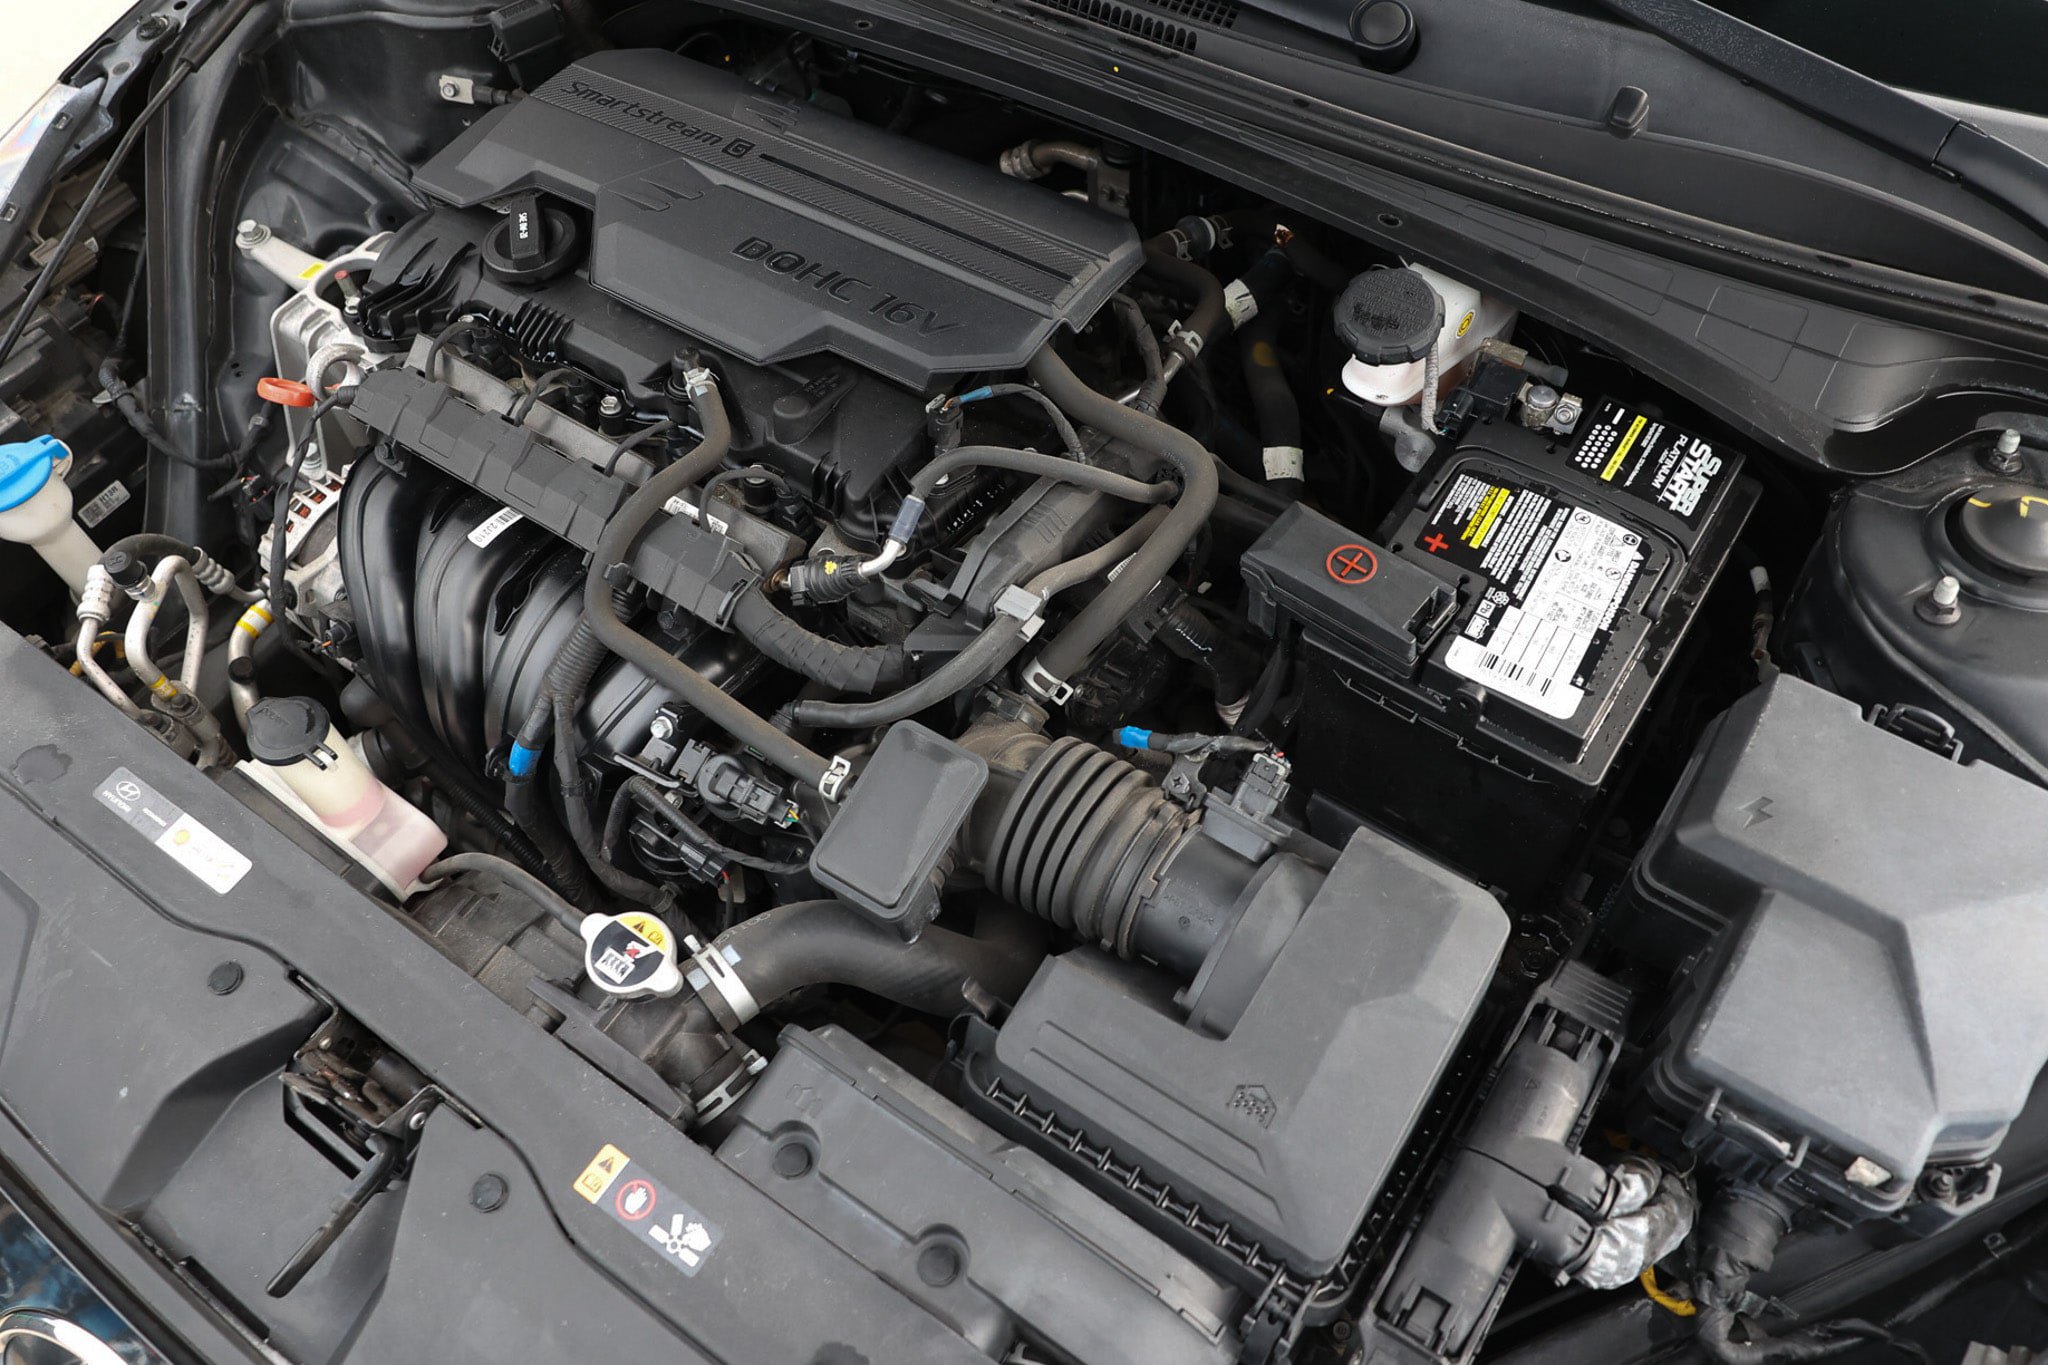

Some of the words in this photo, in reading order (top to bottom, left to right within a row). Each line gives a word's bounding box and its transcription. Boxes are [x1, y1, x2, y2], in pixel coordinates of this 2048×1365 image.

[560, 81, 723, 145] Smartstream
[722, 138, 756, 158] G
[730, 236, 872, 304] DOHC
[868, 292, 967, 337] 16V
[1651, 433, 1688, 489] PLATINUM
[1661, 438, 1713, 511] START
[1676, 455, 1722, 517] SUPER
[1481, 602, 1492, 616] Pb
